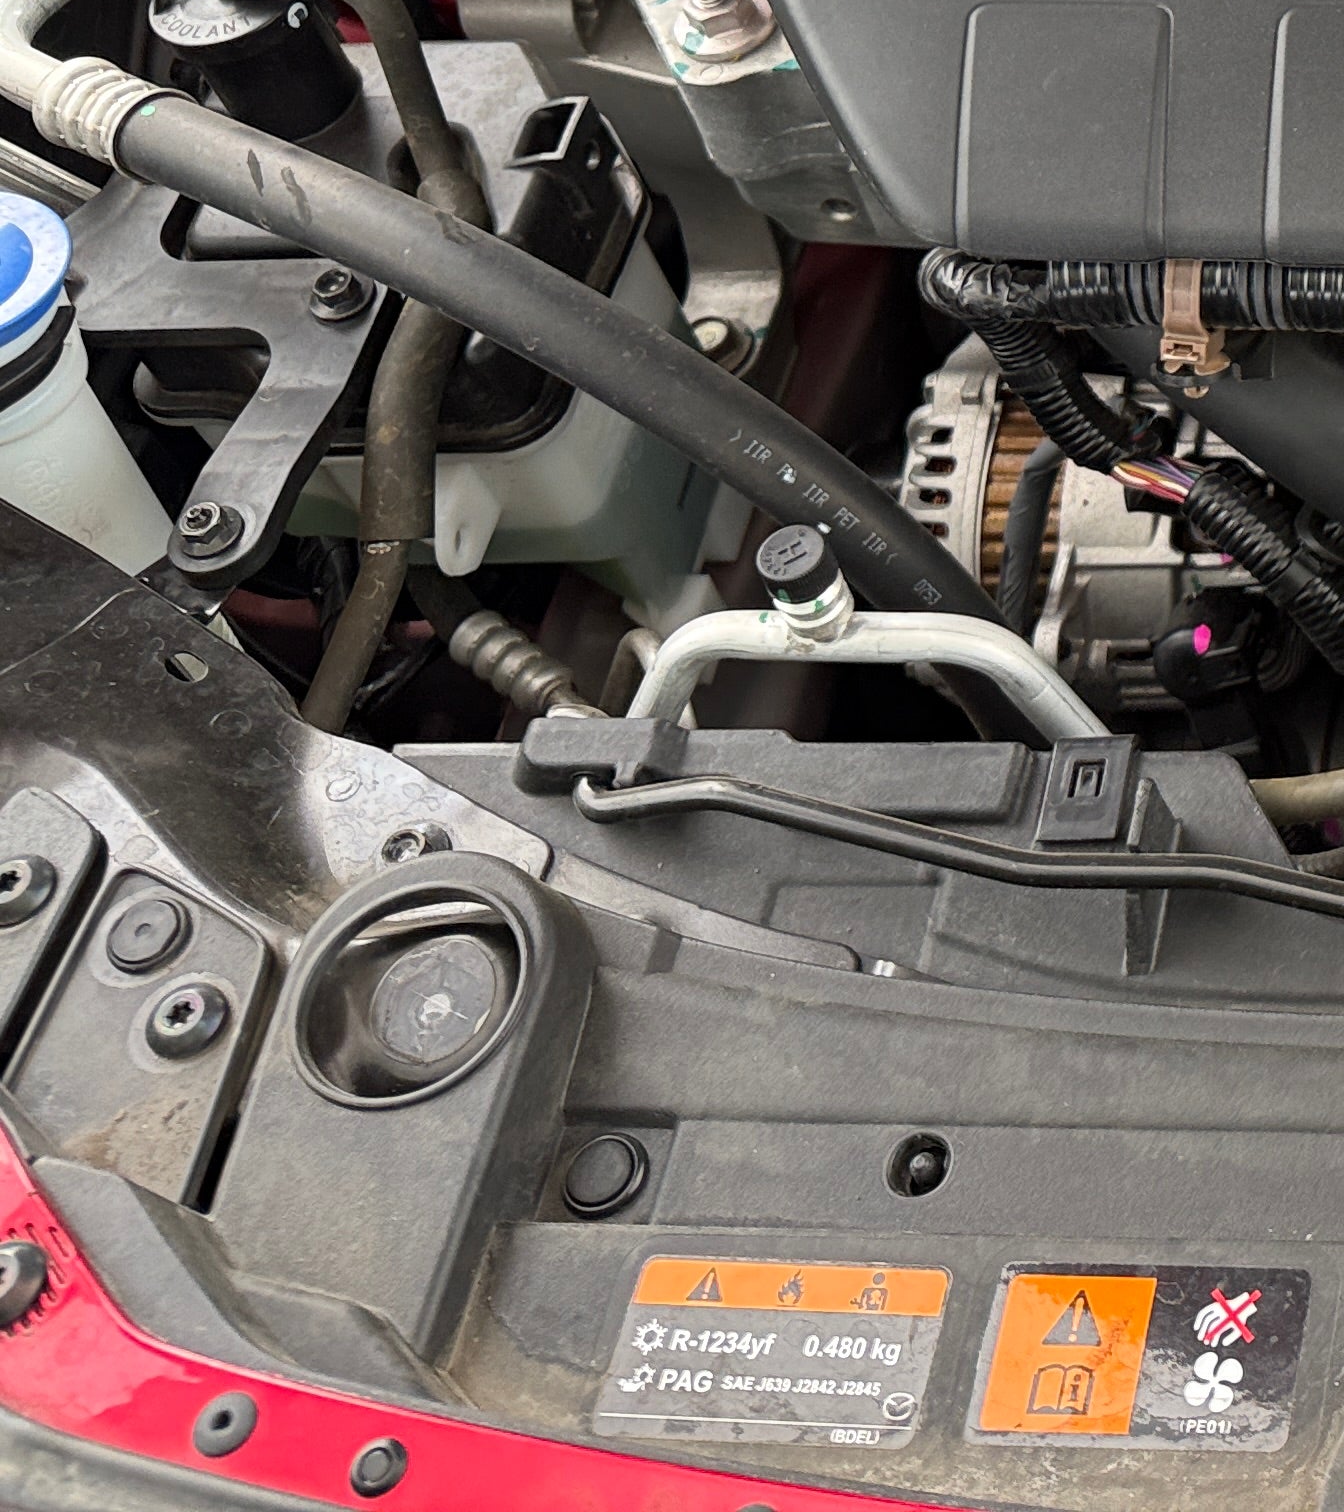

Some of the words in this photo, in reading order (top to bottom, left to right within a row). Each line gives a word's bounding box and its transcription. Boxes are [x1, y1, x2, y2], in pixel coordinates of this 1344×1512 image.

[161, 12, 254, 39] COOLANT
[834, 506, 861, 531] PET
[668, 1328, 777, 1360] R-1234yf
[803, 1334, 867, 1360] 0.480
[869, 1338, 902, 1366] kg
[658, 1368, 714, 1393] PAG
[720, 1375, 756, 1391] SAE
[755, 1377, 792, 1393] J639
[792, 1378, 837, 1395] J2842
[836, 1380, 882, 1397] J2845
[829, 1428, 880, 1445] (BDEL)
[1180, 1419, 1232, 1434] (PE01)
